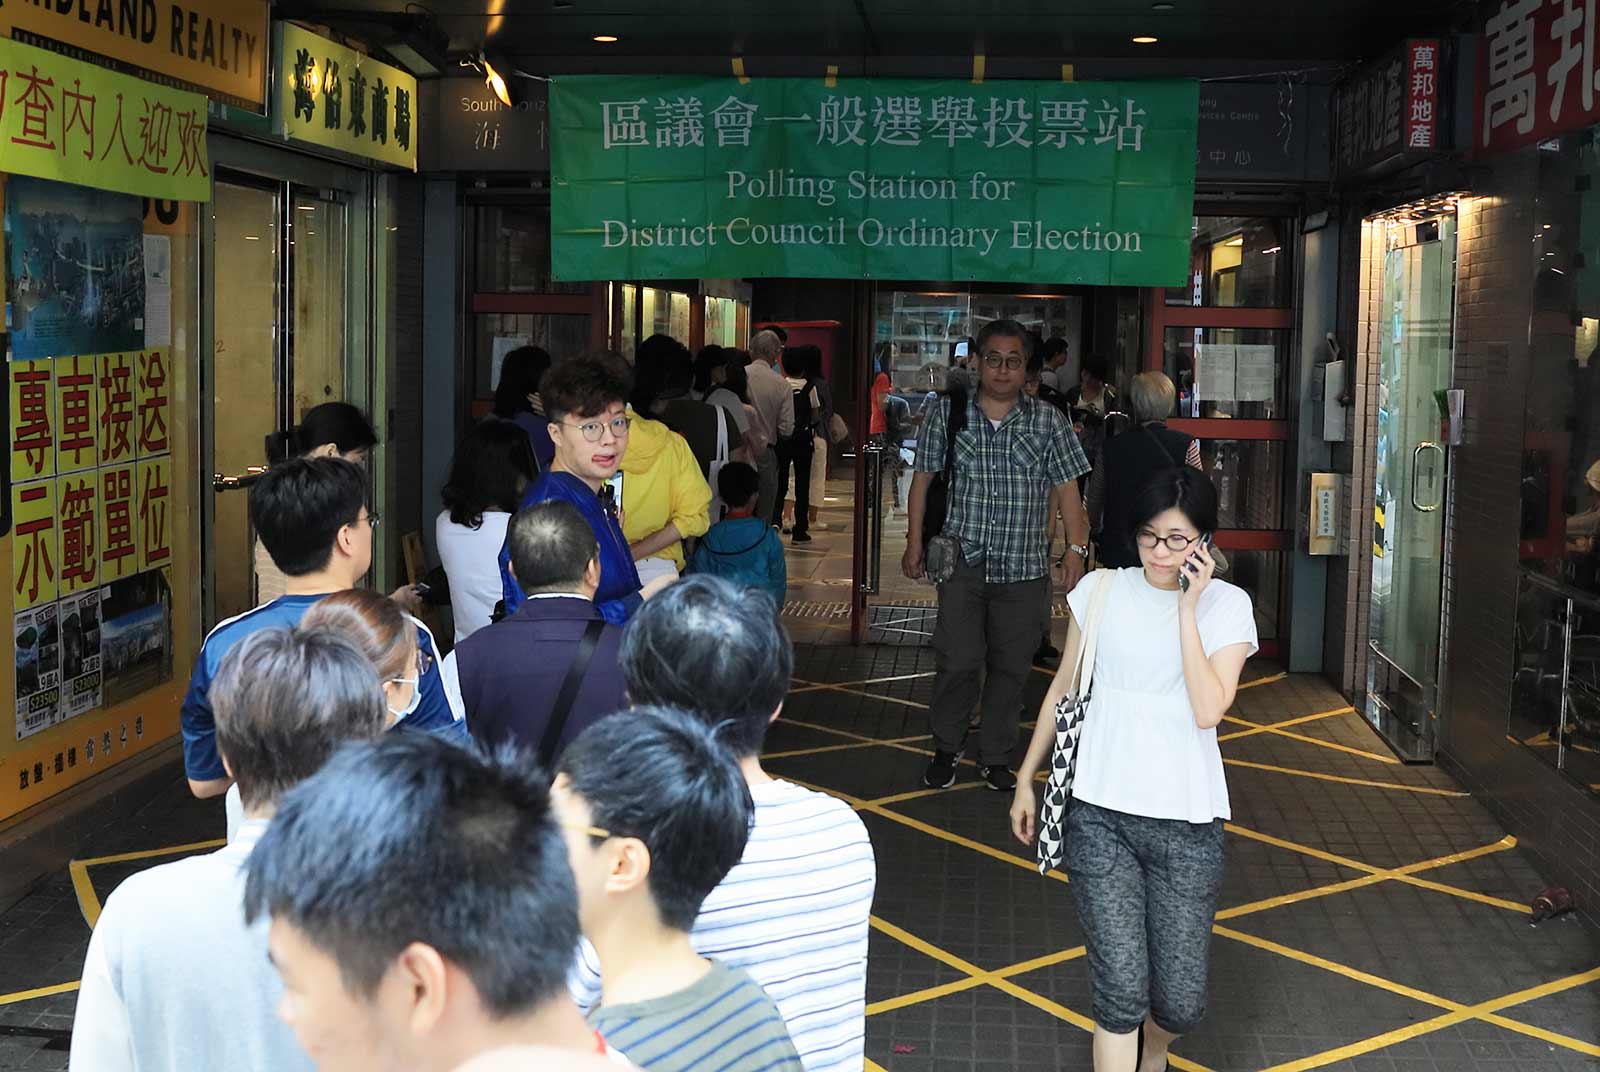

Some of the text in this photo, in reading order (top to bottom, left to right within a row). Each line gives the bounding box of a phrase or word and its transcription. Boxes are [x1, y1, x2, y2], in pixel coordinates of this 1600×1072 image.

[171, 5, 257, 78] REALTY
[600, 95, 1147, 152] 區議會一般選舉投票站
[1409, 45, 1434, 149] 萬邦地產
[727, 168, 1016, 206] Polling Station for
[602, 216, 1143, 256] District Council Ordinary Election
[13, 351, 168, 474] 專車接送
[16, 464, 170, 603] 示範單位
